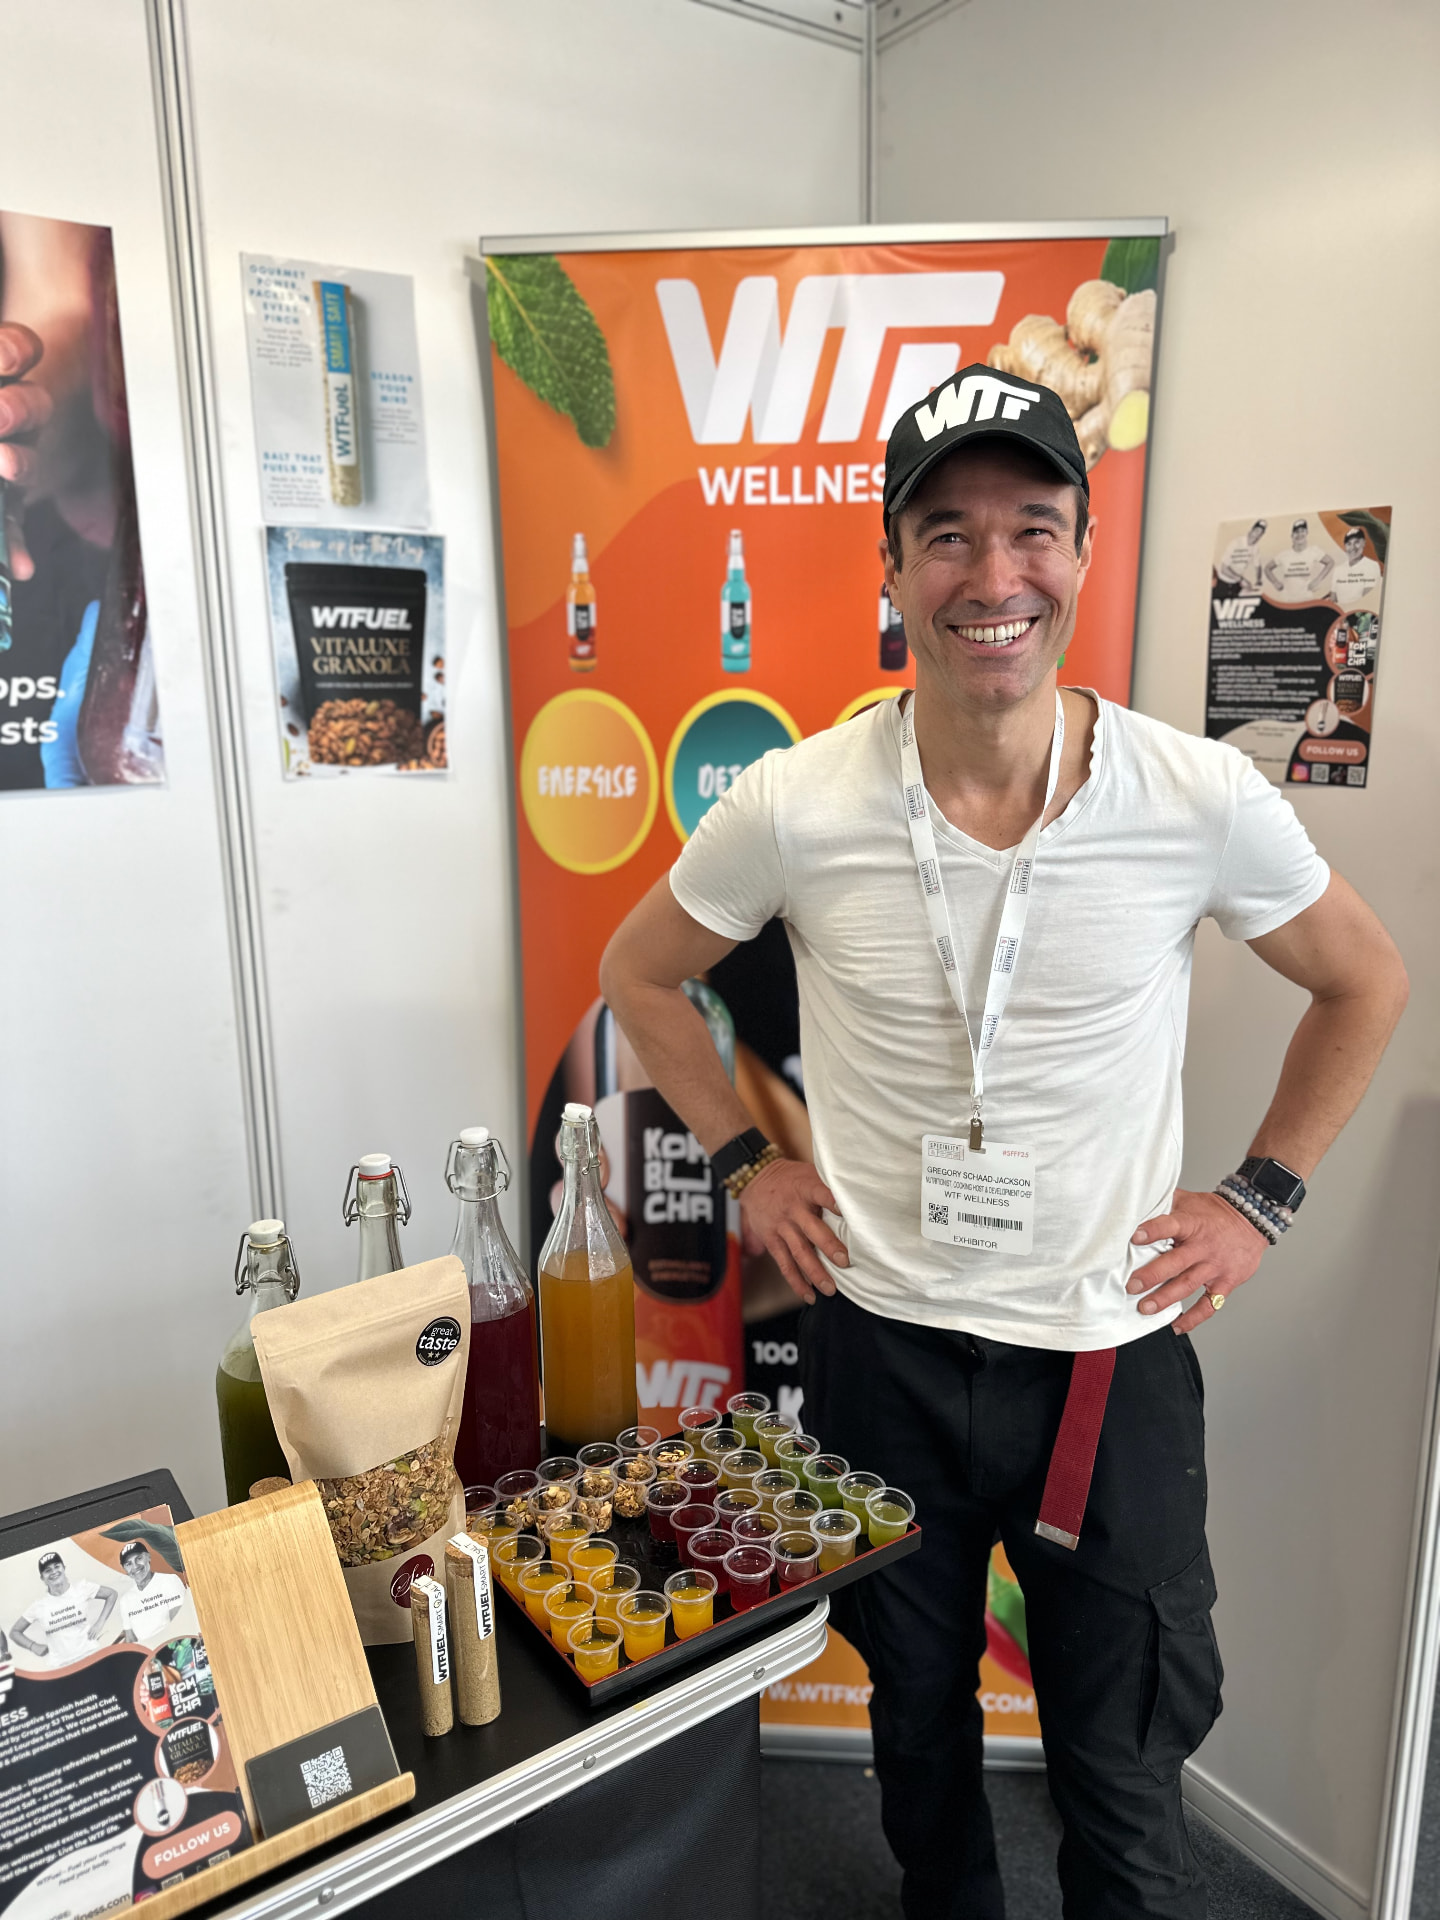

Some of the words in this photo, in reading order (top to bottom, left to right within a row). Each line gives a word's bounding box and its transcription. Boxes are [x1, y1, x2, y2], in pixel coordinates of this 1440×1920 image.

[655, 271, 1005, 444] WTF
[914, 375, 1041, 443] WTF
[311, 606, 412, 631] WTFUEL
[1213, 598, 1261, 620] WTF
[312, 656, 412, 676] GRANOLA
[1306, 745, 1344, 756] FOLLOW
[1346, 748, 1359, 757] US
[537, 763, 638, 799] ENERGISE
[926, 1166, 962, 1178] GREGORY
[962, 1172, 1031, 1187] SCHAAD-JACKSON
[644, 1192, 714, 1224] CHA
[944, 1190, 962, 1200] WTF
[964, 1194, 1010, 1207] WELLNESS
[953, 1234, 998, 1249] EXHIBITOR
[419, 1335, 458, 1350] taste
[431, 1327, 454, 1337] great
[636, 1360, 731, 1413] WTF
[480, 1565, 488, 1590] SMART
[480, 1589, 492, 1637] WTFUEL
[437, 1634, 448, 1682] WTFUEL
[169, 1676, 196, 1695] KOM
[8, 1716, 45, 1734] disruptive
[45, 1703, 74, 1720] Spanish
[75, 1694, 98, 1707] health
[11, 1735, 20, 1744] by
[21, 1722, 50, 1740] Gregory
[61, 1713, 75, 1723] The
[75, 1703, 98, 1717] Global
[99, 1695, 118, 1707] Chef,
[174, 1697, 202, 1717] CHA
[11, 1751, 31, 1764] drink
[32, 1738, 65, 1757] products
[65, 1731, 81, 1741] that
[82, 1724, 97, 1735] fuse
[98, 1711, 128, 1728] wellness
[14, 1736, 44, 1752] Lourdes
[66, 1721, 79, 1731] We
[80, 1712, 102, 1726] create
[103, 1704, 121, 1716] bold,
[167, 1721, 204, 1743] WTFUEL
[28, 1768, 62, 1786] intensely
[62, 1752, 100, 1772] refreshing
[100, 1735, 137, 1756] fermented
[21, 1799, 37, 1810] Salt
[49, 1782, 79, 1798] cleaner,
[78, 1769, 107, 1785] smarter
[107, 1763, 122, 1773] way
[123, 1758, 132, 1766] to
[32, 1778, 62, 1795] flavours
[33, 1809, 62, 1826] Granola
[68, 1796, 93, 1811] gluten
[93, 1788, 110, 1800] free,
[110, 1773, 143, 1792] artisanal,
[14, 1833, 29, 1844] and
[30, 1820, 57, 1837] crafted
[57, 1816, 69, 1825] for
[69, 1803, 99, 1820] modern
[99, 1788, 133, 1807] lifestyles.
[25, 1794, 74, 1818] compromise.
[10, 1849, 44, 1867] wellness
[44, 1840, 60, 1852] that
[61, 1828, 90, 1845] excites,
[90, 1812, 125, 1832] surprises,
[14, 1865, 28, 1876] the
[28, 1853, 57, 1871] energy.
[58, 1845, 74, 1856] Live
[74, 1839, 88, 1849] the
[88, 1829, 105, 1842] WTF
[106, 1825, 120, 1835] life.
[154, 1831, 210, 1867] FOLLOW
[213, 1822, 231, 1838] US
[76, 1869, 91, 1880] your
[83, 1856, 97, 1866] your
